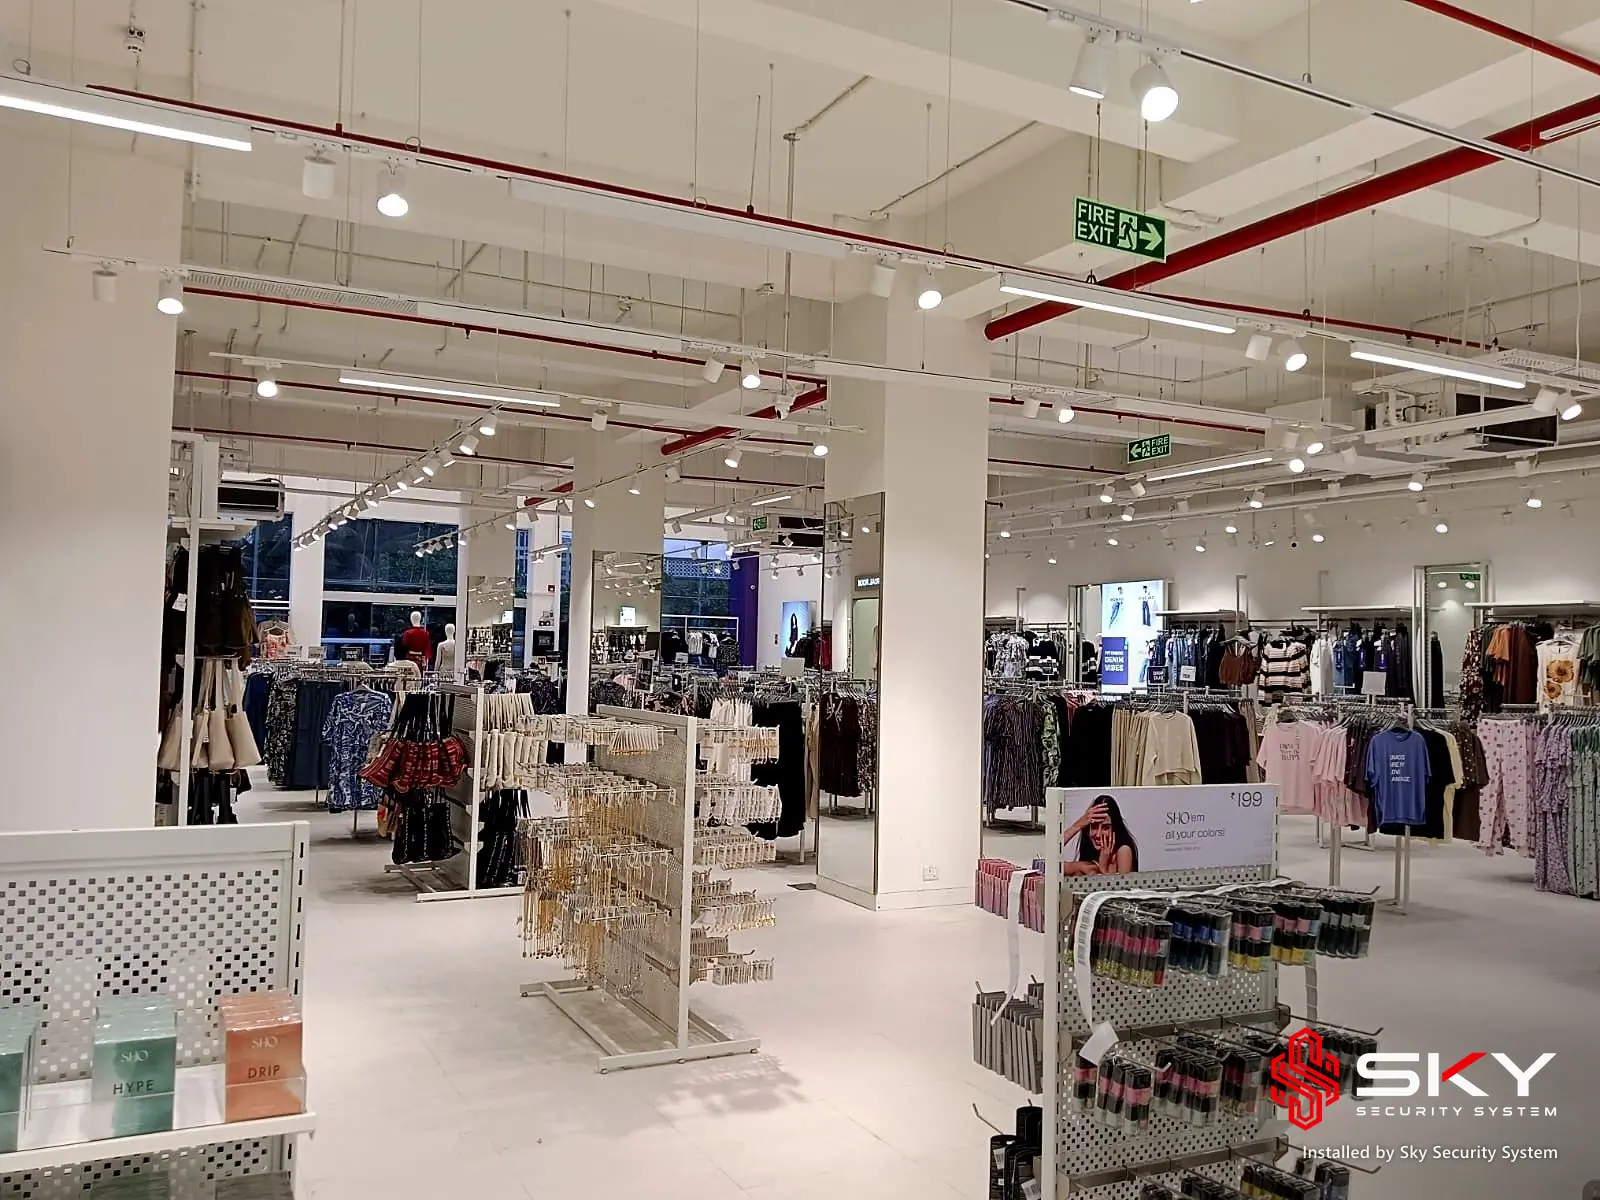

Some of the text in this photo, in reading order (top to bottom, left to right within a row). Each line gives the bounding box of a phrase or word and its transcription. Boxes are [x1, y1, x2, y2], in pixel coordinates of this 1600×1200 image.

[1078, 201, 1115, 226] FIRE
[1077, 220, 1115, 245] EXIT
[1151, 436, 1169, 447] FIRE
[1151, 444, 1169, 456] EXIT
[1165, 830, 1175, 840] all
[1176, 830, 1196, 841] your
[251, 1035, 279, 1050] SHO
[120, 1050, 149, 1063] SHO
[247, 1064, 281, 1080] DRIP
[112, 1079, 155, 1096] HYPE
